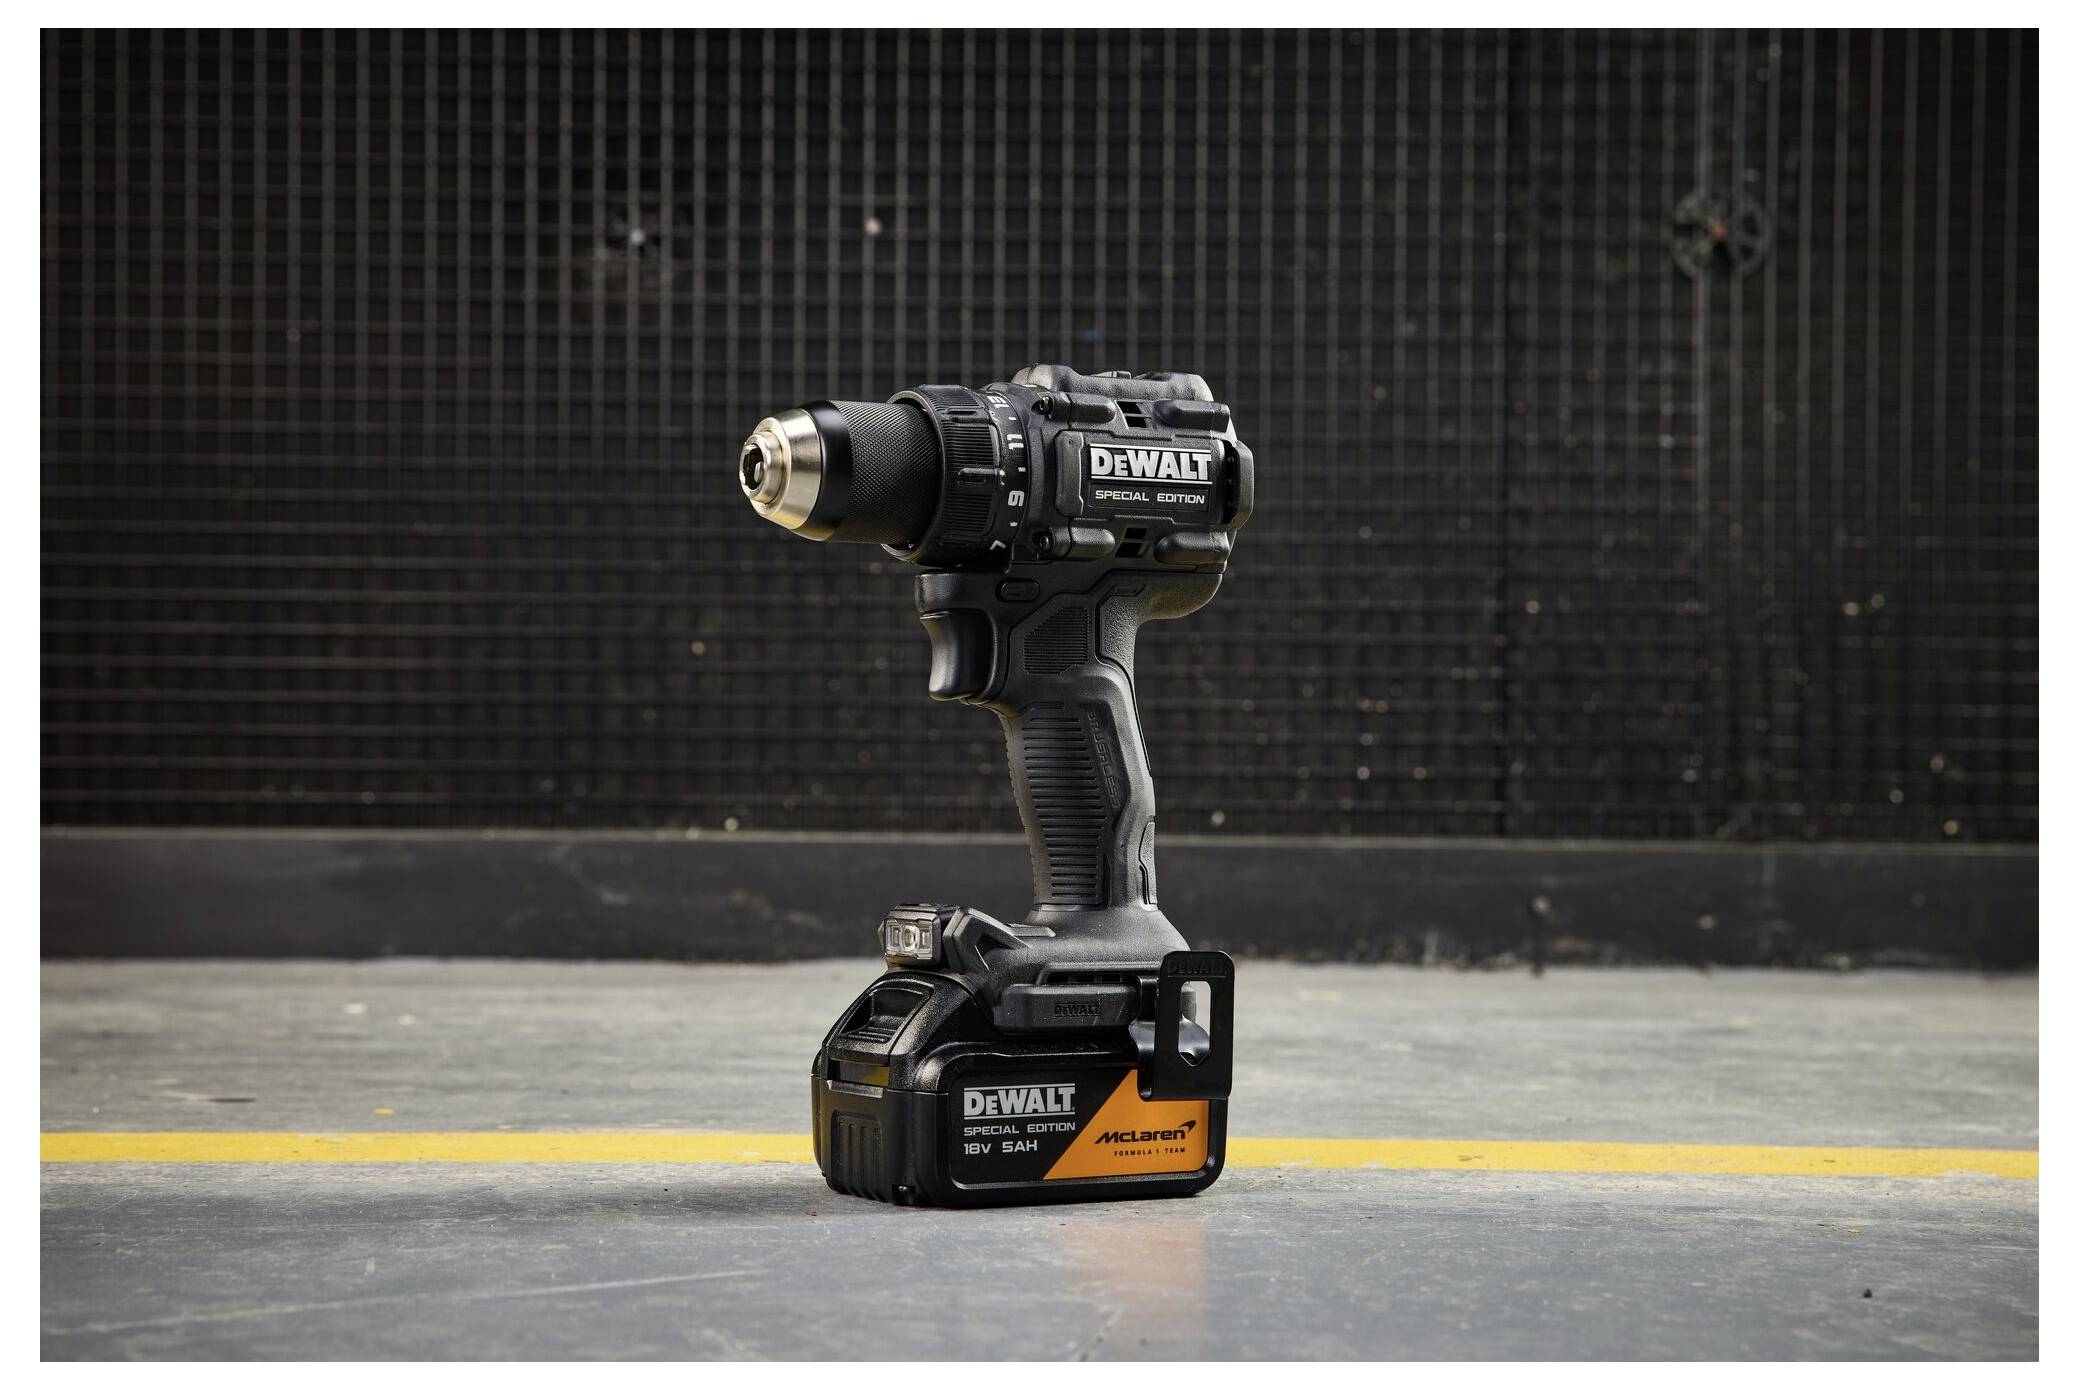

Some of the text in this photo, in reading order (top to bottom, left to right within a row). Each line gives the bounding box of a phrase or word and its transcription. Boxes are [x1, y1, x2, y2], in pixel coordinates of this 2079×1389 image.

[1006, 433, 1025, 450] 11
[1095, 490, 1205, 504] SPECIAL EDITION
[963, 1121, 1076, 1136] SPECIAL EDITION
[1094, 1129, 1186, 1144] McLaren
[963, 1139, 1038, 1155] 18V 5AH
[1114, 1148, 1152, 1157] FORMULA
[1165, 1146, 1186, 1154] TEAM
